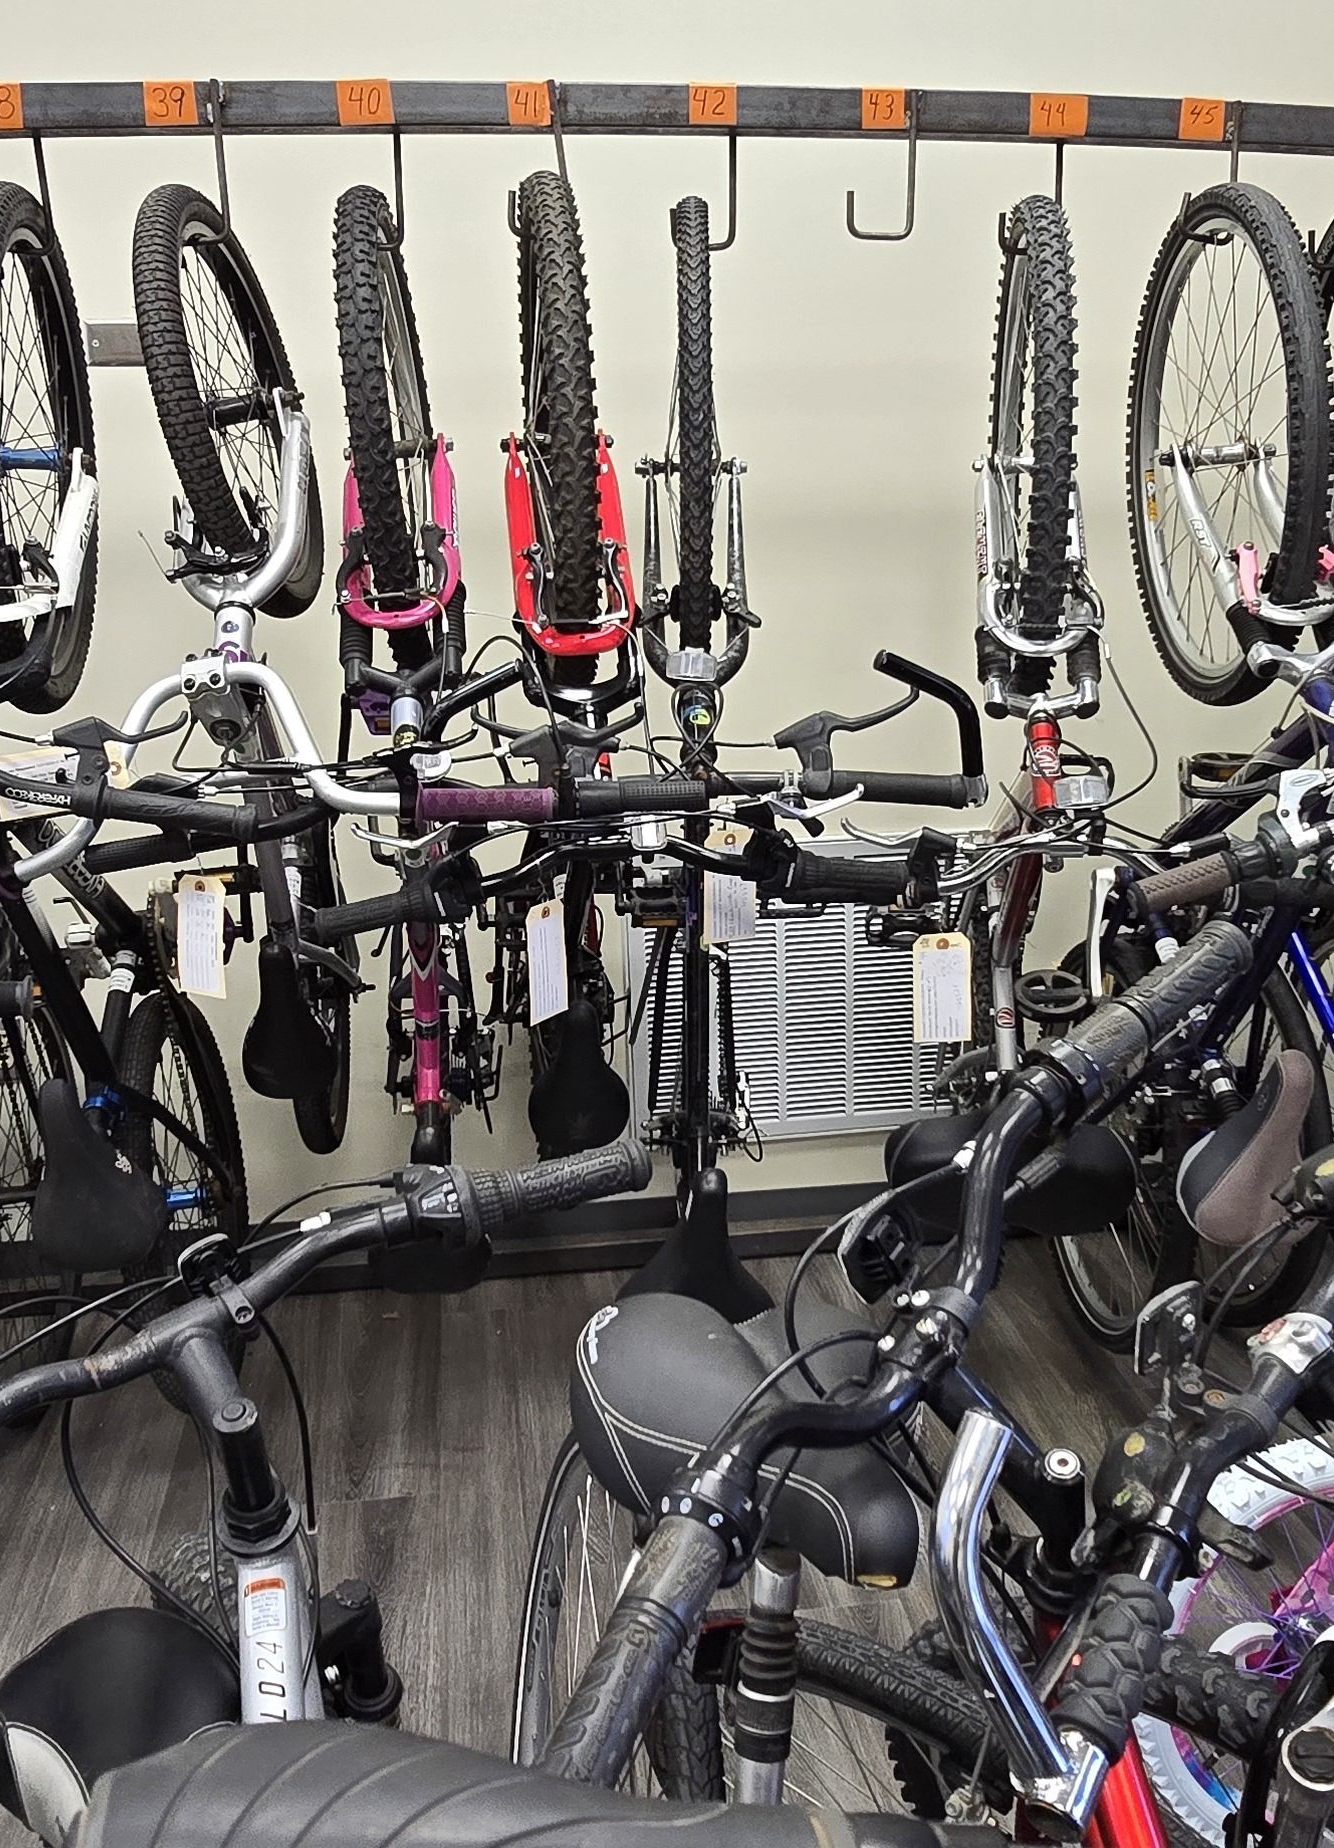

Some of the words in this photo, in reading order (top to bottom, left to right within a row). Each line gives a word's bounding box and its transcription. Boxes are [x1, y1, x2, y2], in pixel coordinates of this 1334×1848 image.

[153, 86, 184, 118] 39
[348, 85, 381, 115] 40
[515, 89, 540, 120] 41
[693, 88, 726, 116] 42
[870, 94, 897, 122] 43
[1041, 102, 1067, 127] 44
[1190, 103, 1217, 128] 45
[1190, 519, 1211, 547] RST
